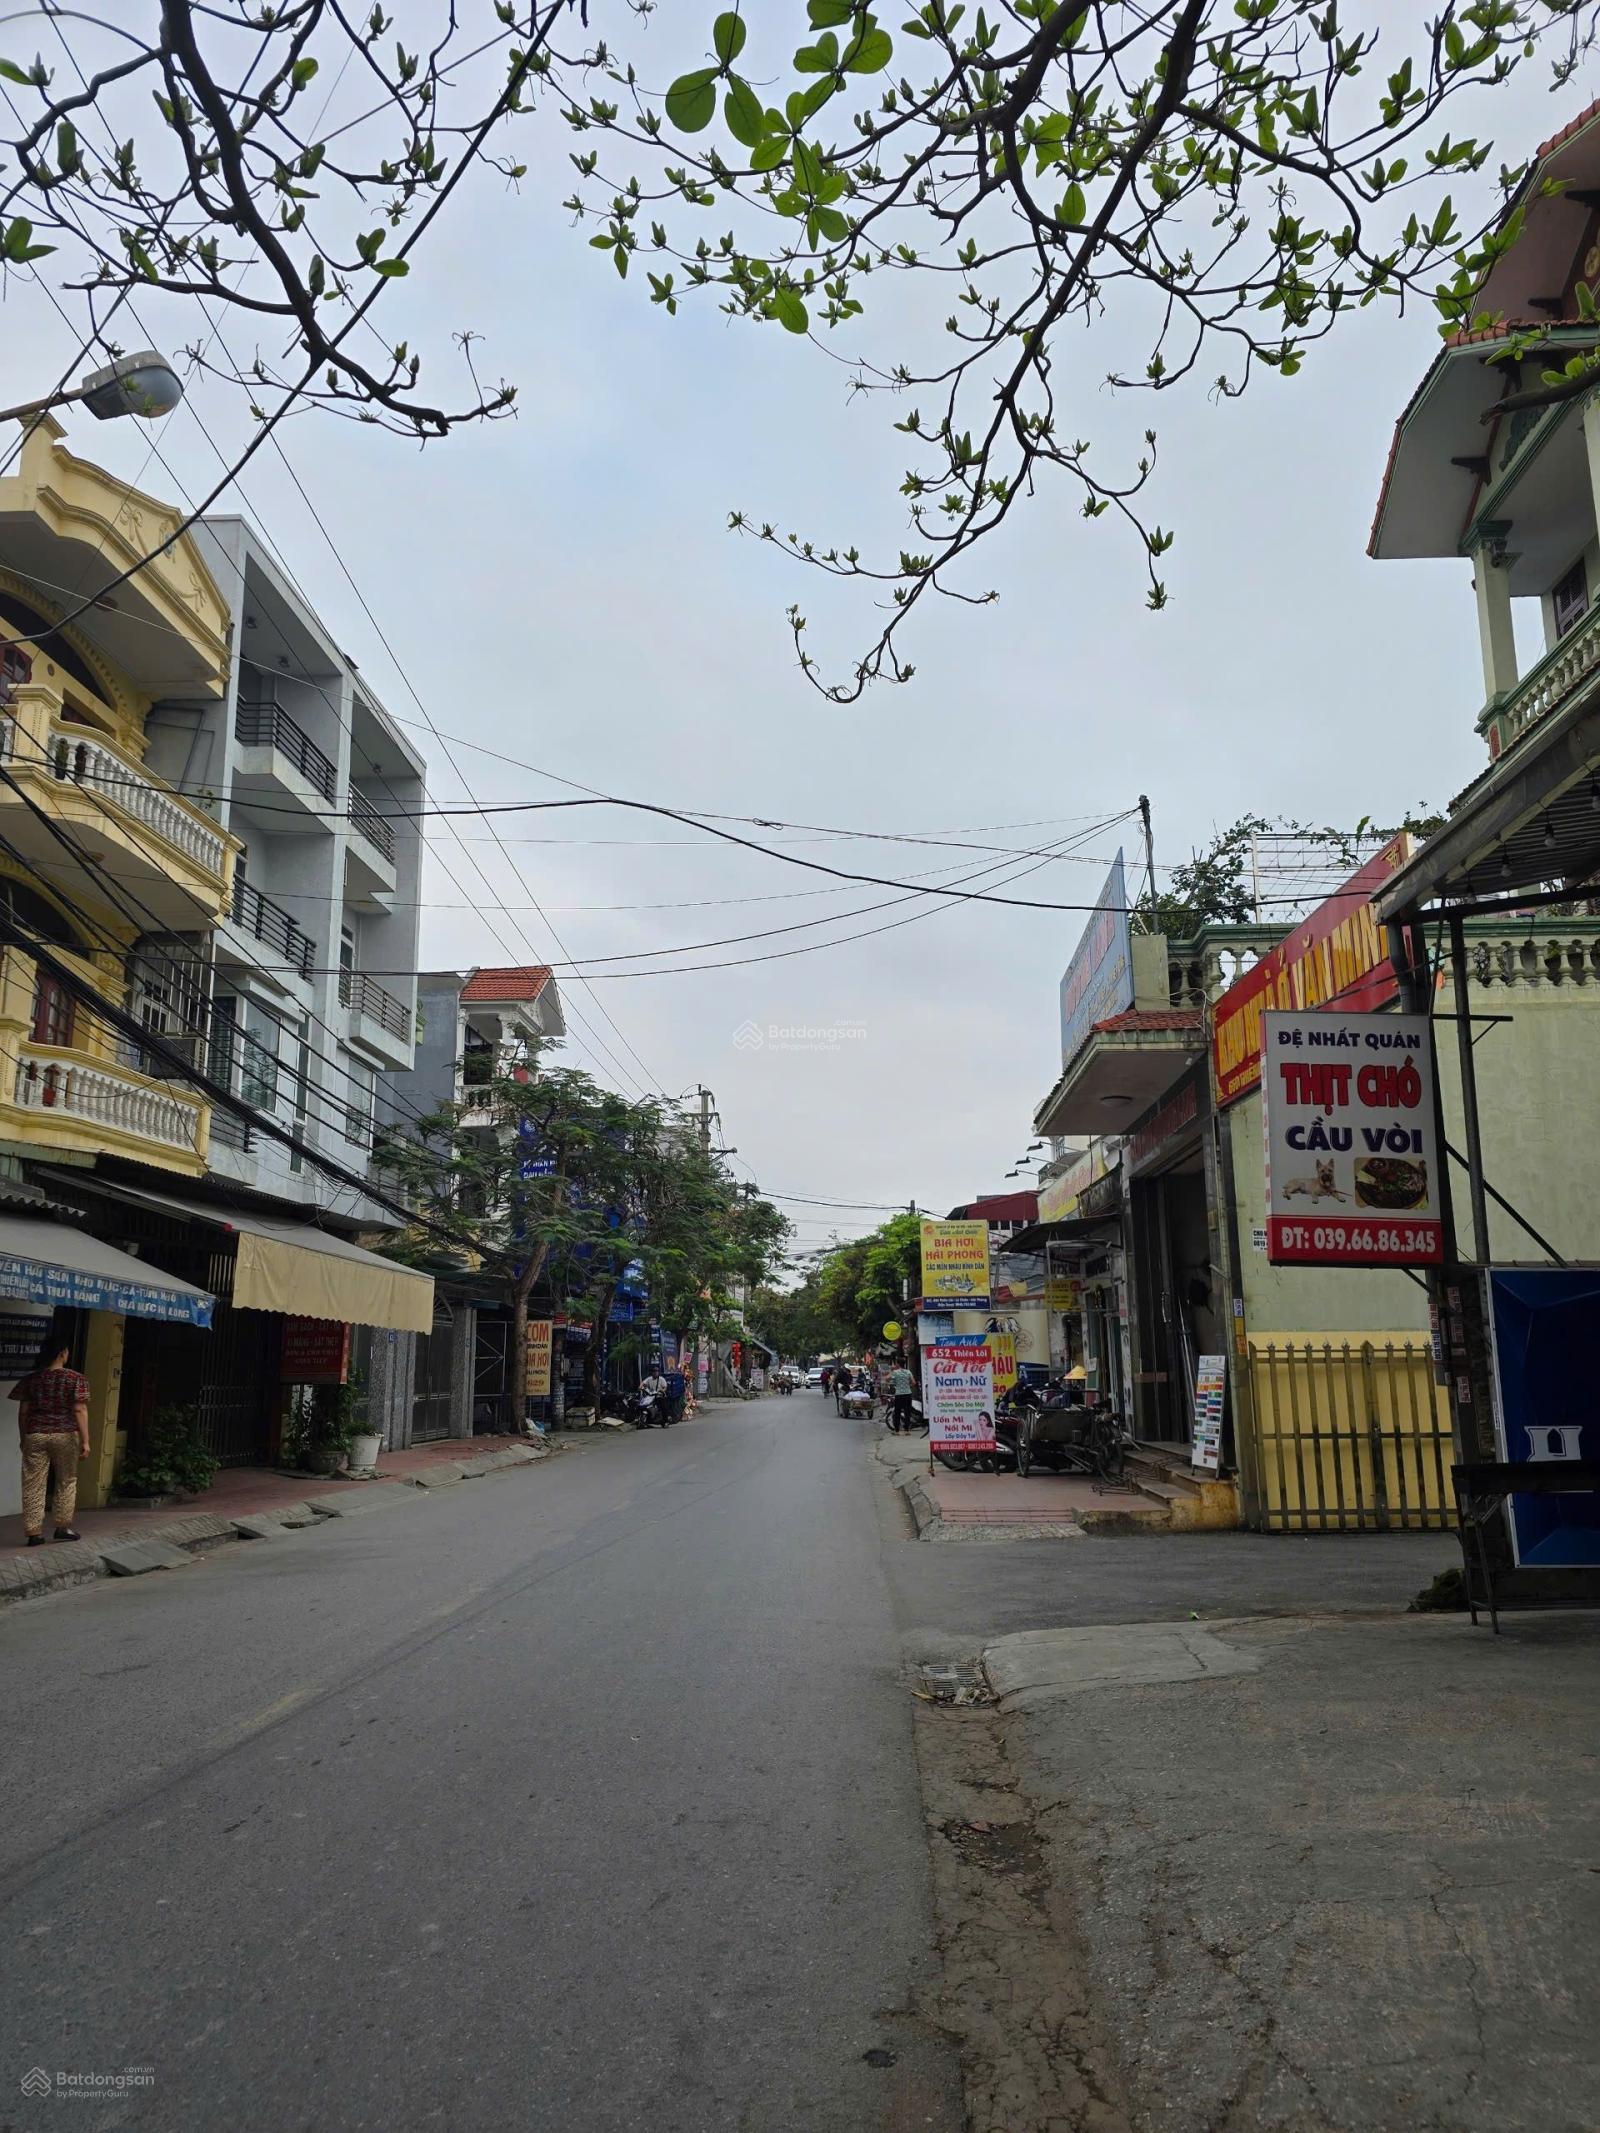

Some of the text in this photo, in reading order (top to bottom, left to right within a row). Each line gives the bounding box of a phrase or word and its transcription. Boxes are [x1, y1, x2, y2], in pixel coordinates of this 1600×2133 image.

[1278, 1027, 1420, 1050] ĐỆ NHẤT QUÁN
[1281, 1063, 1352, 1116] THỊT
[1357, 1054, 1422, 1108] CHÓ
[1285, 1116, 1423, 1154] CẦU VÒI
[934, 1238, 975, 1247] BIA HƠI
[1281, 1227, 1436, 1253] ĐT: 039.66.86.345
[926, 1249, 984, 1260] HẢI PHÒNG
[932, 1348, 987, 1357] 652 Thiên Lôi
[936, 1375, 987, 1386] Nam Nữ
[944, 1424, 959, 1432] Nối
